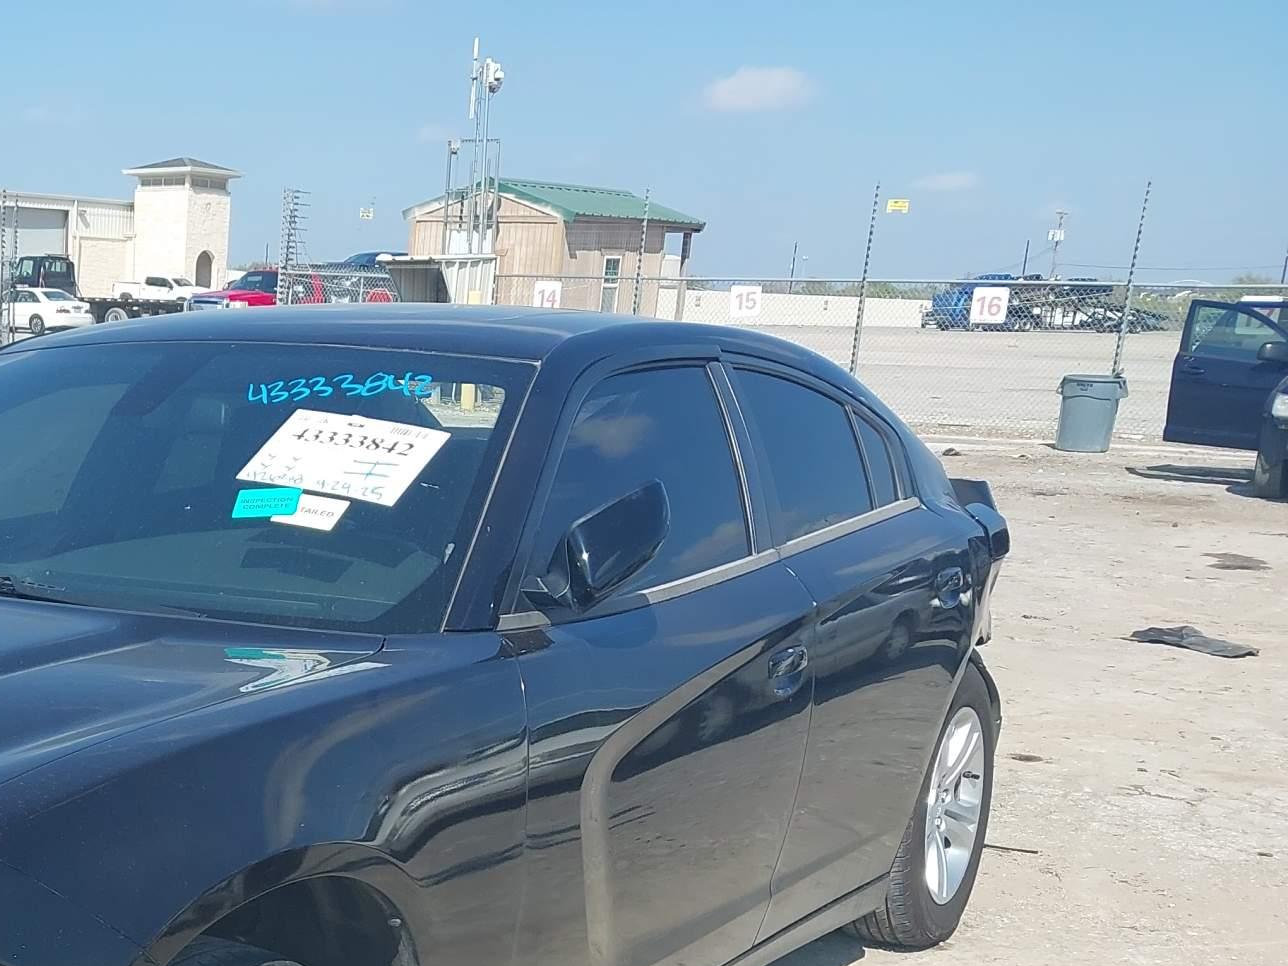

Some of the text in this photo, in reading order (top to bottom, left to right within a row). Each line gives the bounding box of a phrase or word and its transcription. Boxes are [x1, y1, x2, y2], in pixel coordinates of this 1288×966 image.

[538, 289, 558, 308] 14
[736, 291, 757, 310] 15
[977, 296, 1002, 316] 16
[248, 372, 432, 404] 43333842
[291, 428, 415, 457] 43333842
[240, 496, 294, 504] INSPECTION
